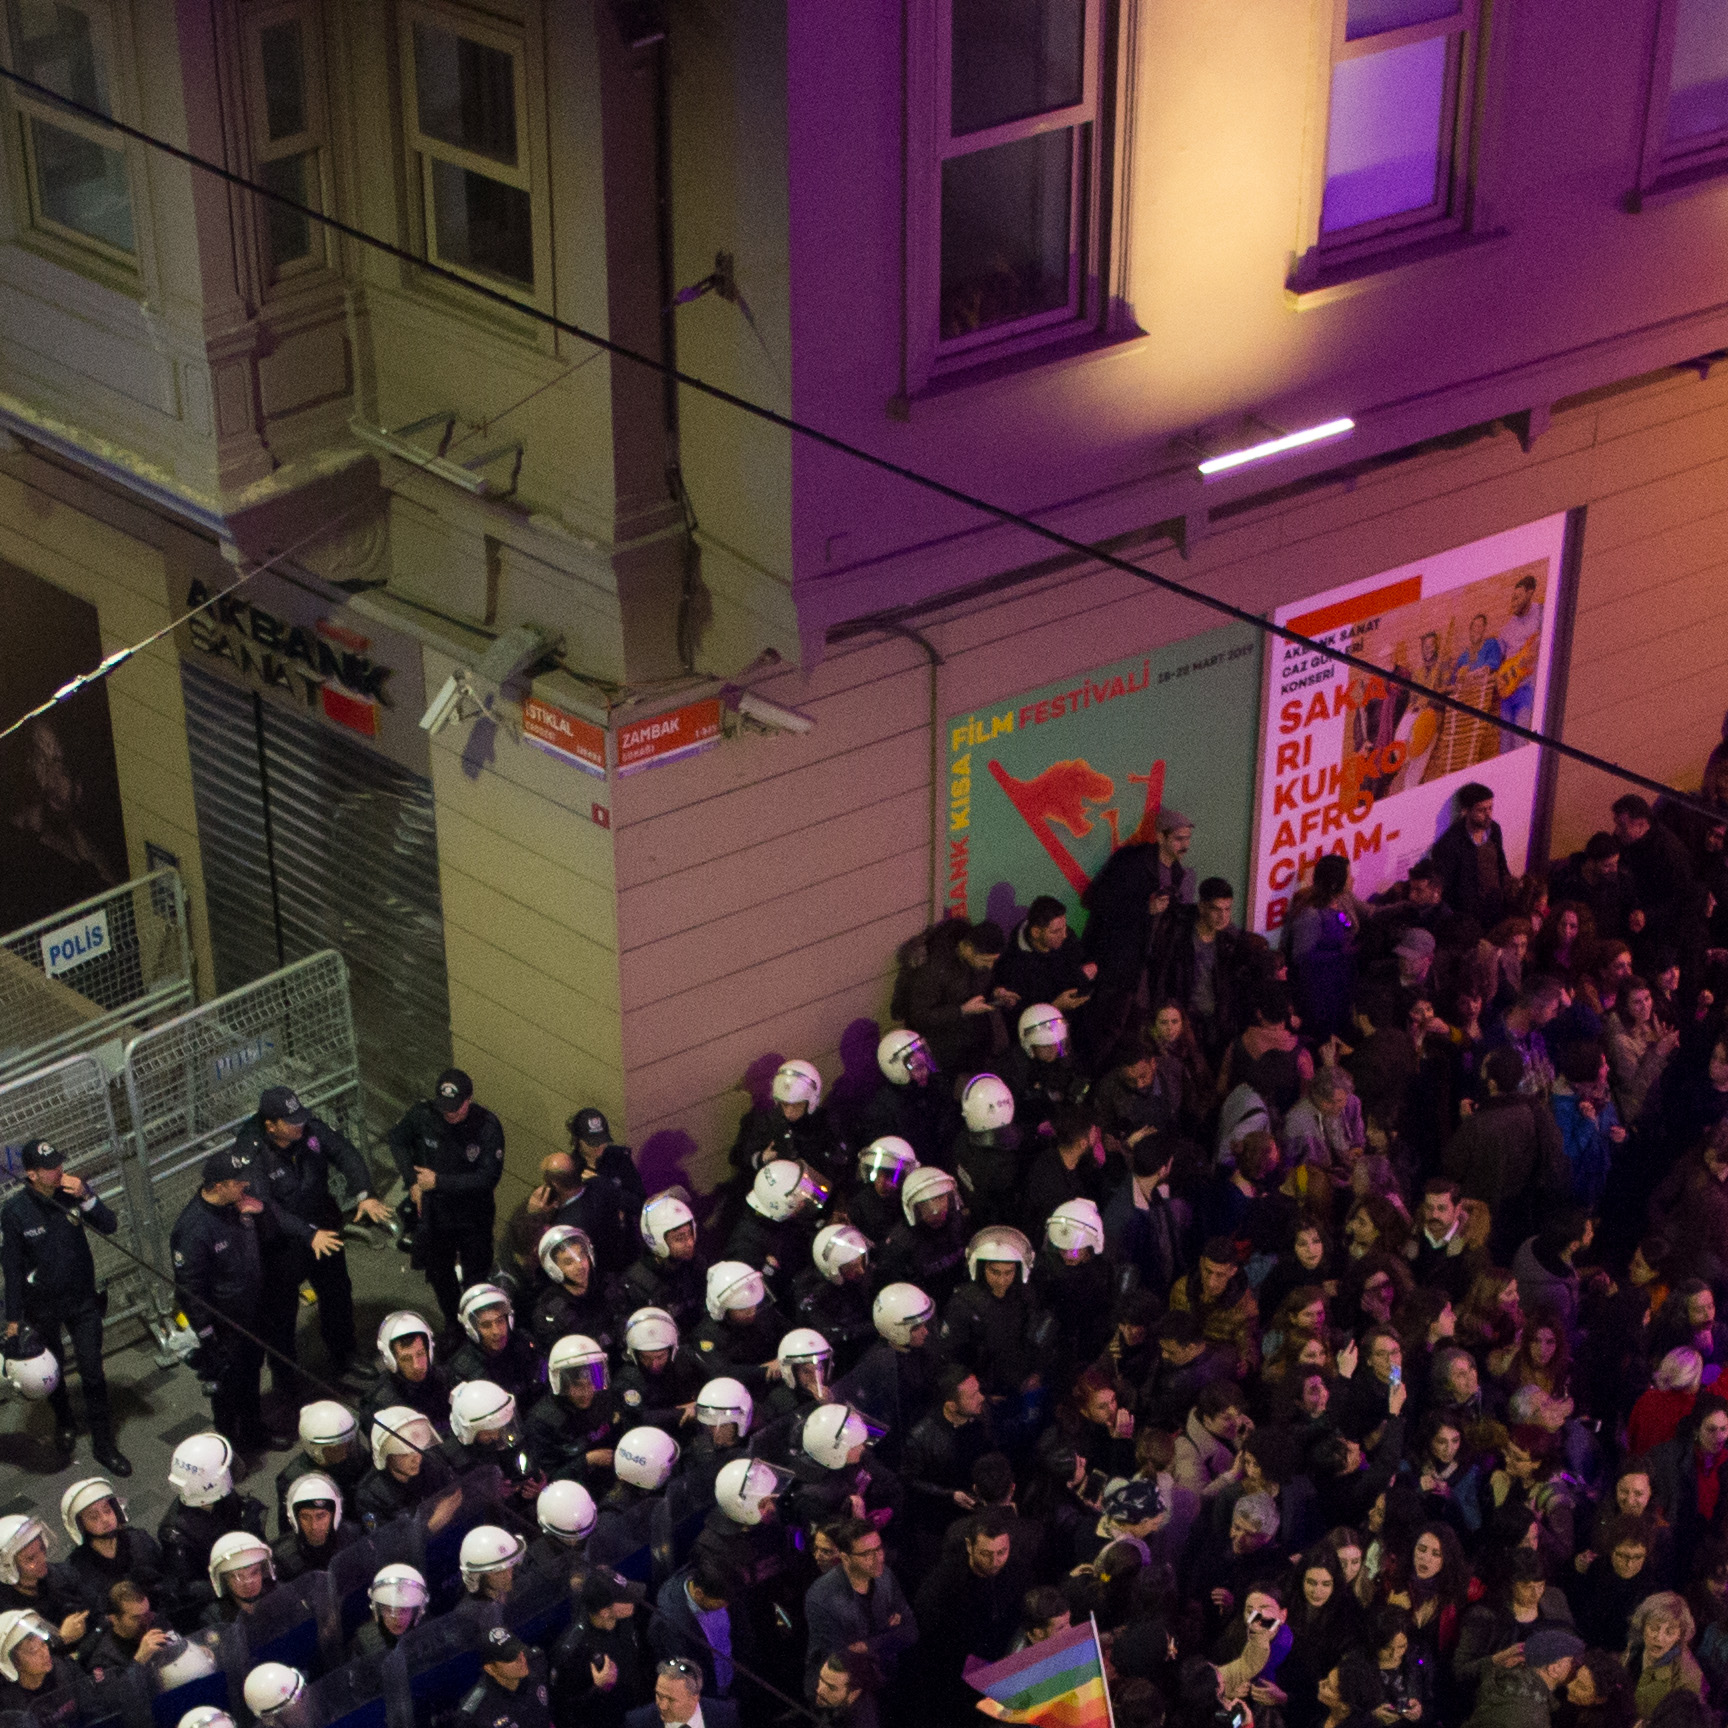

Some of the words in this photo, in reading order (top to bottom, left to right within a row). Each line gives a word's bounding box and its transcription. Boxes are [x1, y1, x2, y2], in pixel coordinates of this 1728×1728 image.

[187, 577, 394, 710] AKBANK
[189, 615, 322, 707] SANAT
[622, 717, 680, 749] ZAMBAK
[951, 711, 1014, 752] FİLM
[1019, 659, 1150, 730] FESTİVALİ
[1279, 677, 1386, 734] SAKA
[1273, 740, 1406, 816] KUKKO
[1276, 735, 1311, 776] RI
[950, 753, 971, 832] KISA
[1270, 791, 1373, 856] AFRO
[50, 926, 103, 966] POLİS
